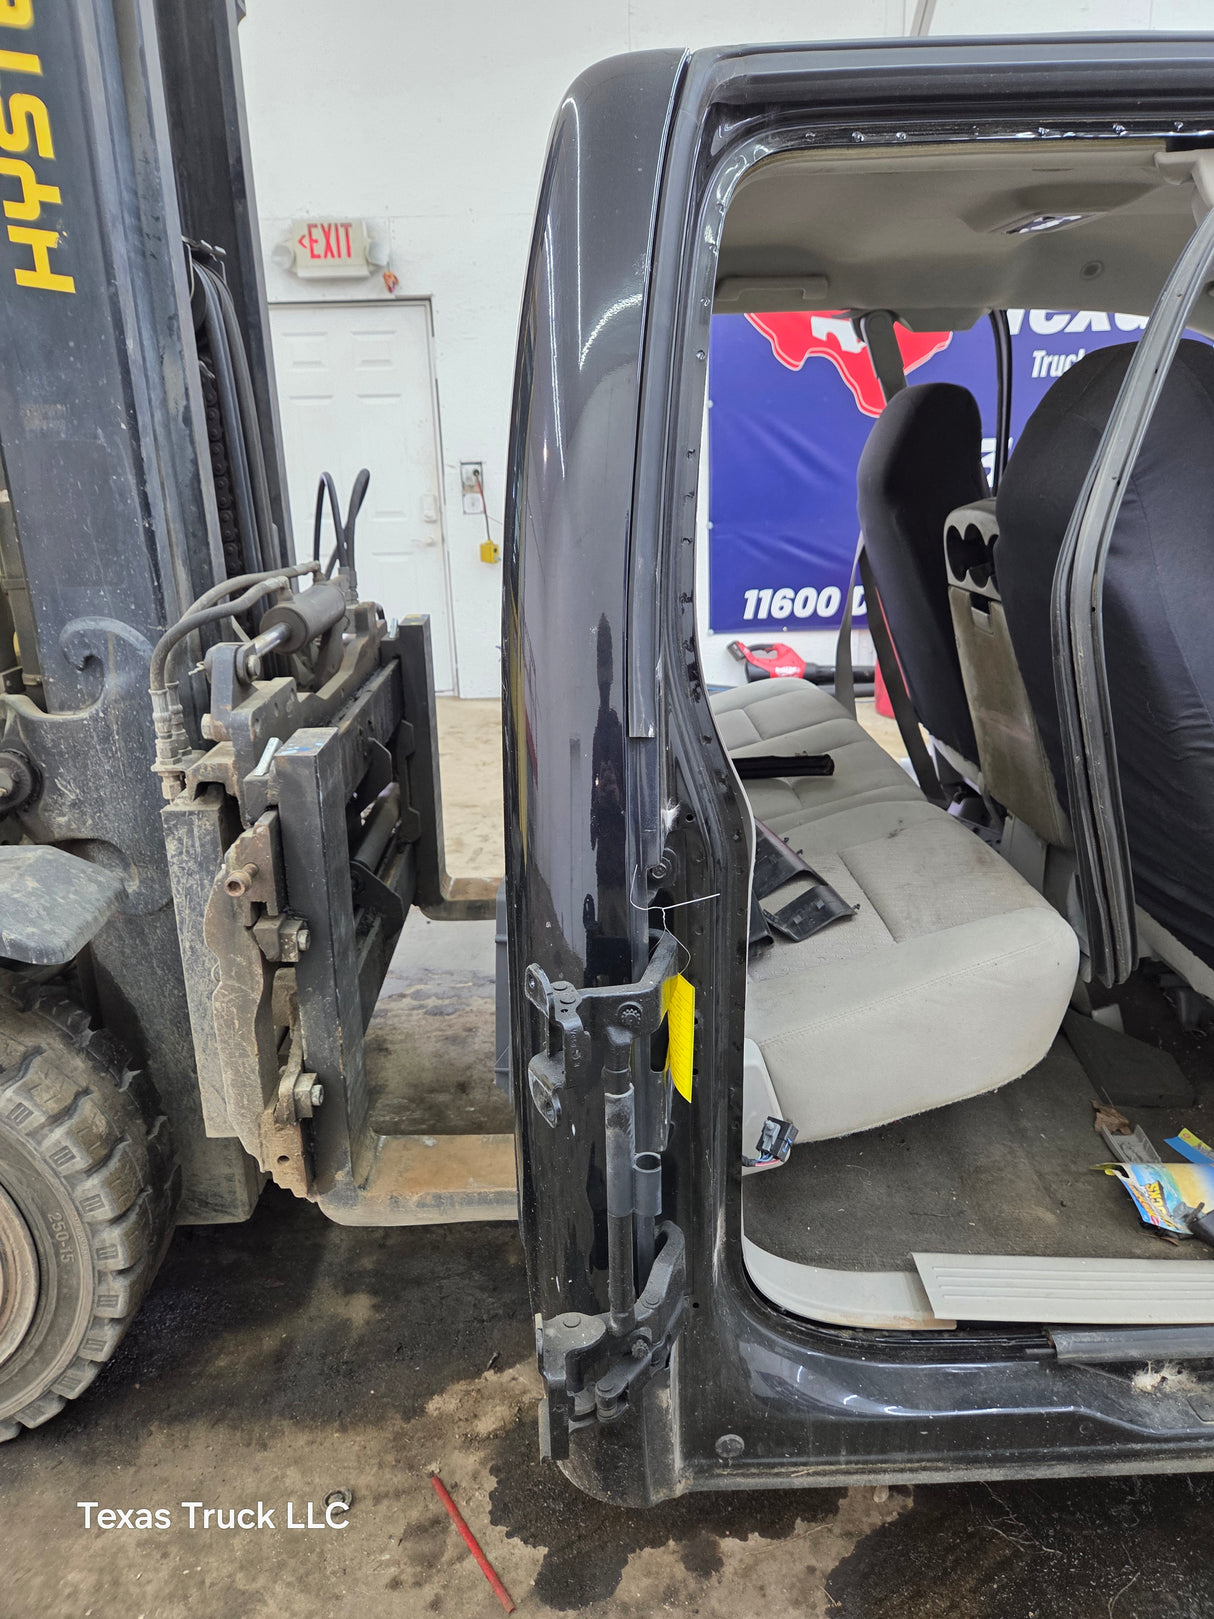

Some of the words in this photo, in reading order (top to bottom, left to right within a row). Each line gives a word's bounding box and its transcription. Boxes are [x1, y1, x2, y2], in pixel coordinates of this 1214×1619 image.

[306, 222, 353, 260] EXIT
[1031, 348, 1086, 378] Truc
[743, 585, 841, 620] 11600
[48, 1212, 75, 1264] 250-15
